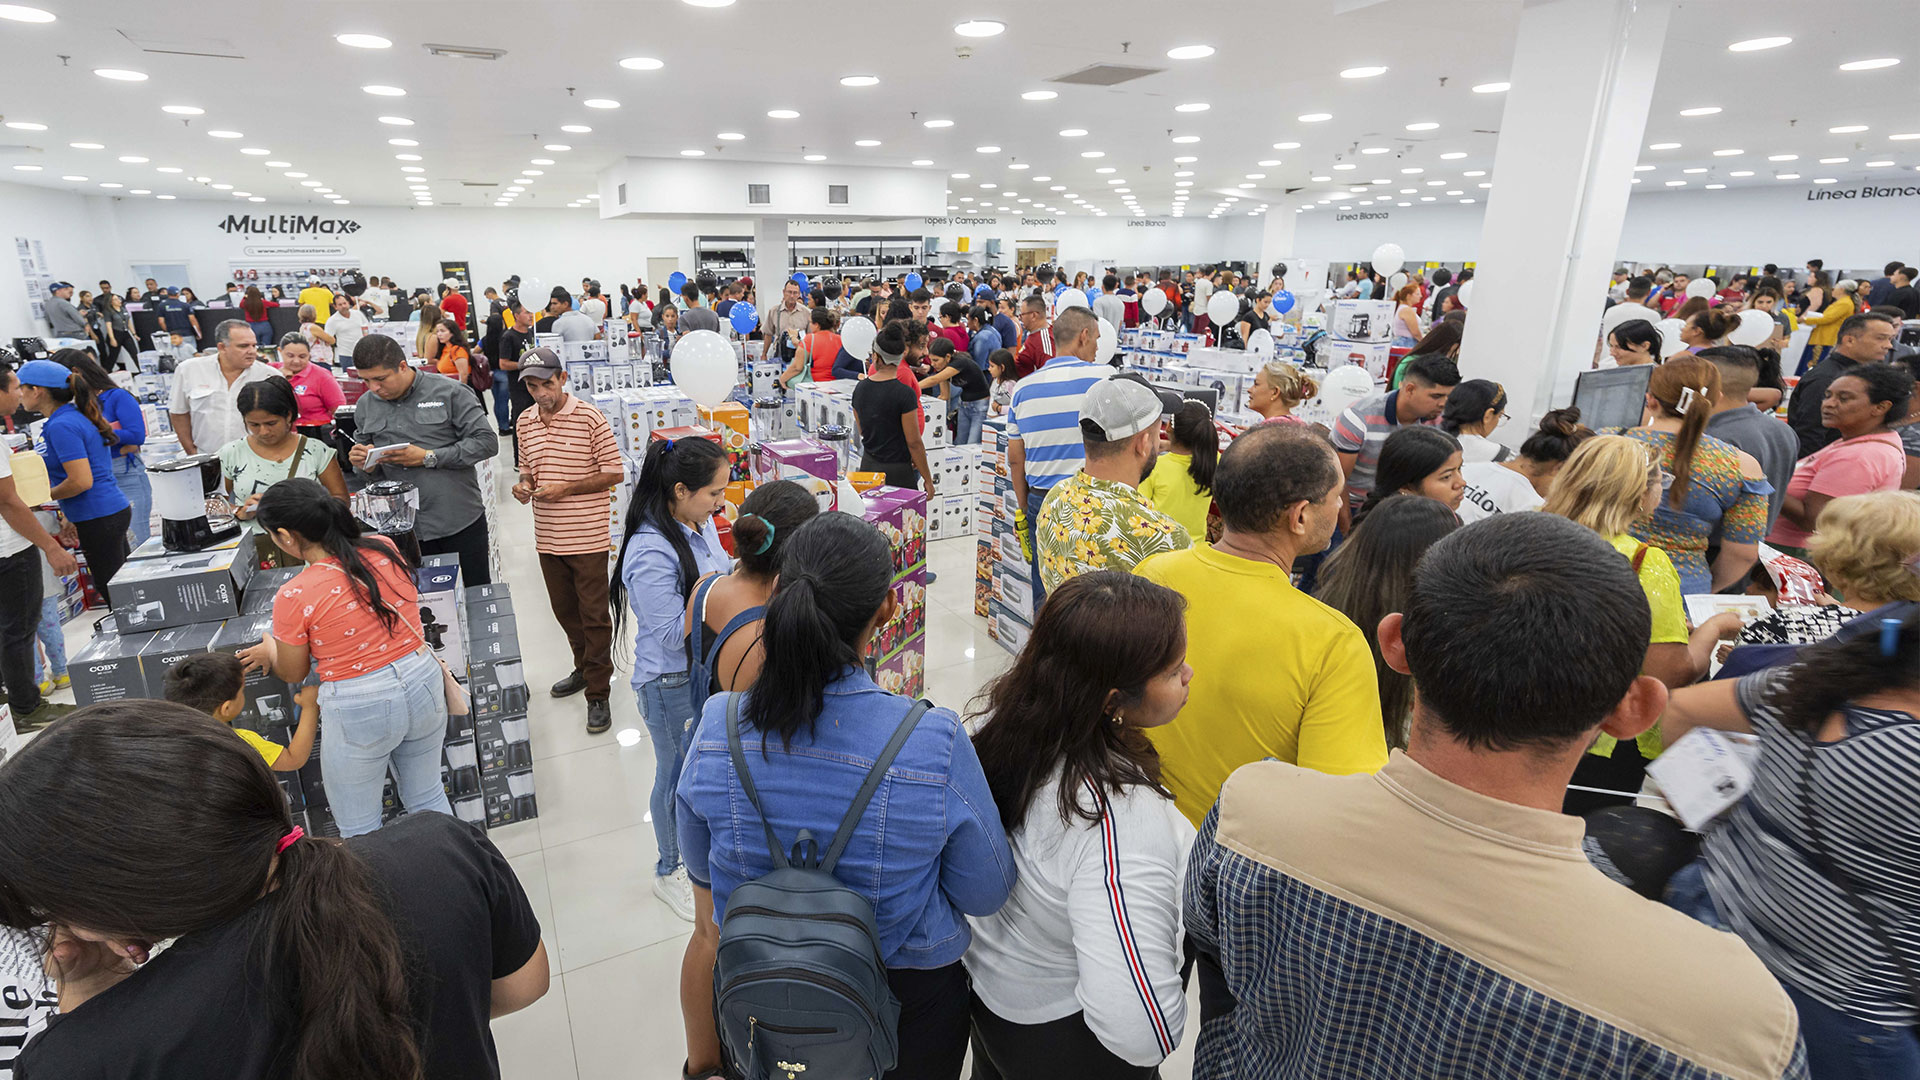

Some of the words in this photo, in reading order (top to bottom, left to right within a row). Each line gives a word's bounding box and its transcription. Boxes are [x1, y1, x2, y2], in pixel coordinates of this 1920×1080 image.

[1807, 188, 1857, 200] Línea
[1359, 212, 1389, 220] Blanca
[226, 215, 351, 233] MultiMax
[924, 217, 947, 227] Topes
[949, 218, 954, 226] y
[955, 217, 997, 226] Campanas
[1021, 217, 1056, 227] Despacho
[1145, 219, 1166, 227] Blanca
[219, 583, 229, 604] COBY
[89, 663, 118, 672] COBY
